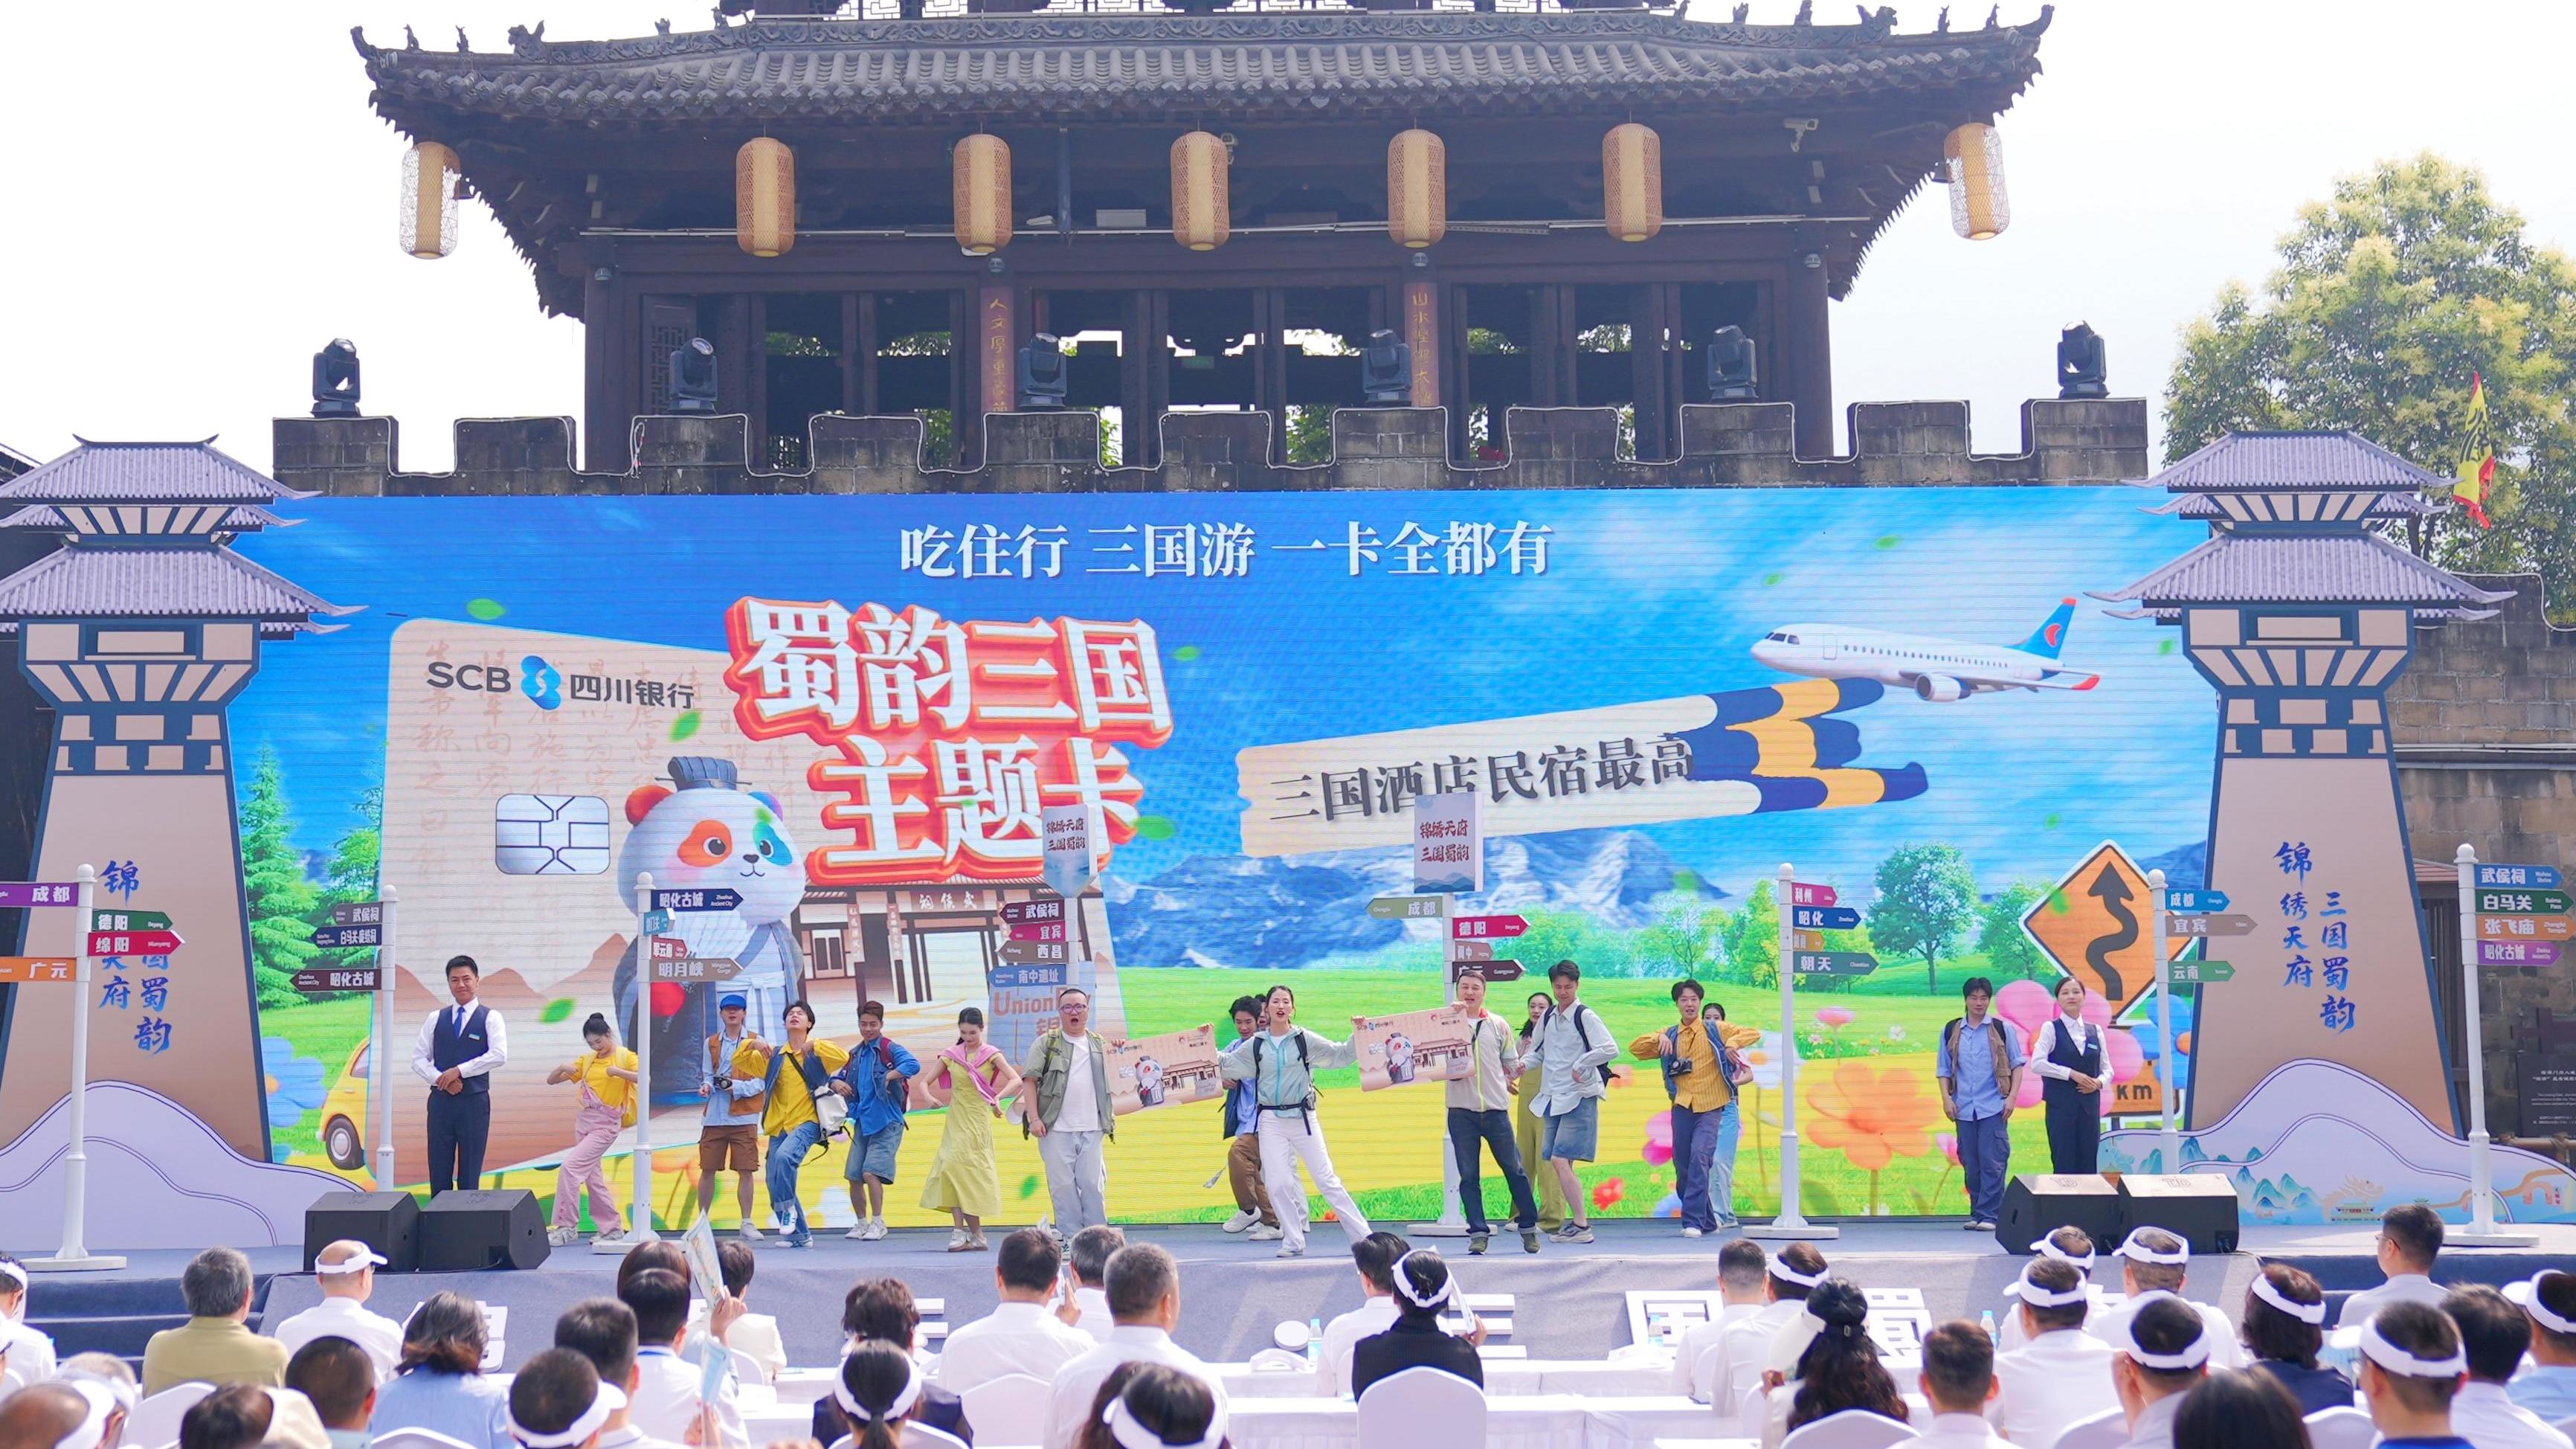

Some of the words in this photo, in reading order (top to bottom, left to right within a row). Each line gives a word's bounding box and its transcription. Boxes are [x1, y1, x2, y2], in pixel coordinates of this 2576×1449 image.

[901, 522, 1069, 578] 吃住行
[1085, 522, 1255, 578] 三国游
[1272, 521, 1552, 577] 一卡全都有
[735, 597, 1169, 735] 蜀韵三国
[427, 661, 511, 693] SCB
[570, 674, 695, 709] 四川银行
[1269, 736, 1695, 820] 三国酒店民宿最高
[823, 735, 1144, 867] 主题卡
[2482, 868, 2525, 884] 武侯祠
[32, 886, 70, 902] 成都
[660, 893, 703, 907] 昭化古城
[2171, 893, 2195, 907] 成都
[1408, 902, 1436, 915] 成都
[2484, 894, 2532, 910] 白马关
[352, 907, 379, 922] 武侯祠
[1025, 903, 1059, 918] 武侯祠
[1799, 910, 1823, 925] 昭化
[2273, 842, 2313, 987] 锦绣天府
[98, 914, 128, 930] 德阳
[1459, 921, 1486, 936] 德阳
[2174, 919, 2206, 933] 宜宾
[2485, 919, 2534, 934] 张飞庙
[1040, 925, 1061, 939] 宜宾
[95, 937, 129, 952] 绵阳
[1037, 944, 1062, 958] 西昌
[2485, 945, 2525, 960] 昭化古城
[29, 963, 67, 979] 广元
[659, 962, 703, 977] 明月峡
[1800, 956, 1831, 971] 朝天
[2319, 892, 2355, 1035] 三国蜀韵
[329, 971, 374, 986] 昭化古城
[2174, 966, 2198, 979] 云南
[2116, 1085, 2152, 1099] km
